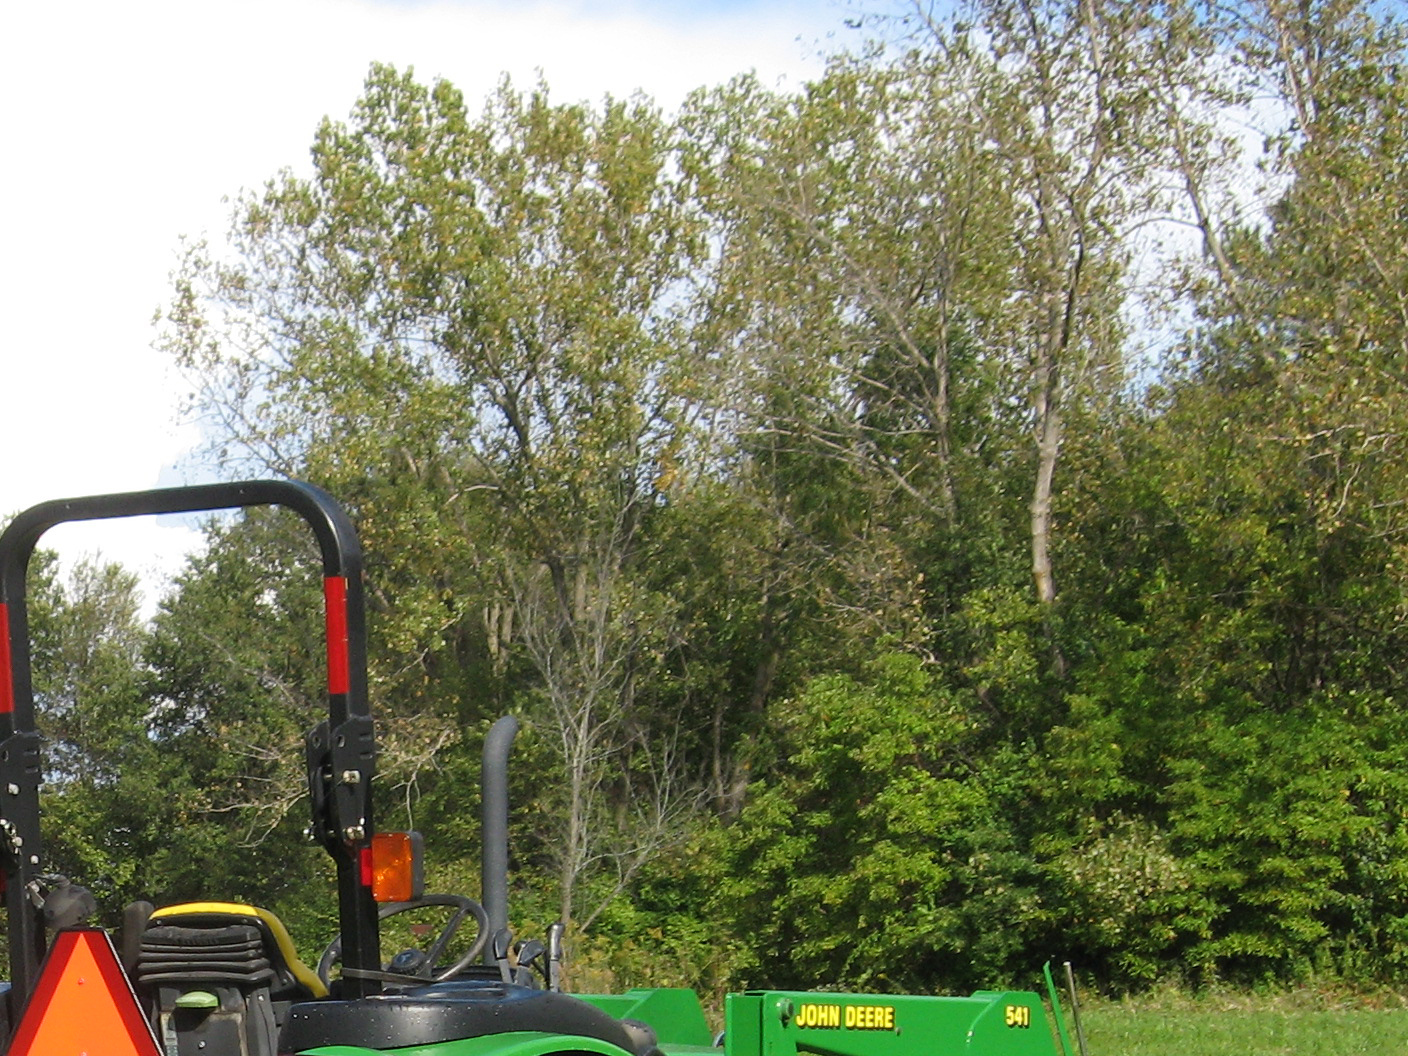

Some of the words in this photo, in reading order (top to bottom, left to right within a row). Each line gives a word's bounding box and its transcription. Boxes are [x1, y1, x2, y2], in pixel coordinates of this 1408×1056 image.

[796, 1004, 840, 1028] JOHN
[845, 1005, 895, 1029] DEERE
[1005, 1006, 1030, 1028] 541
